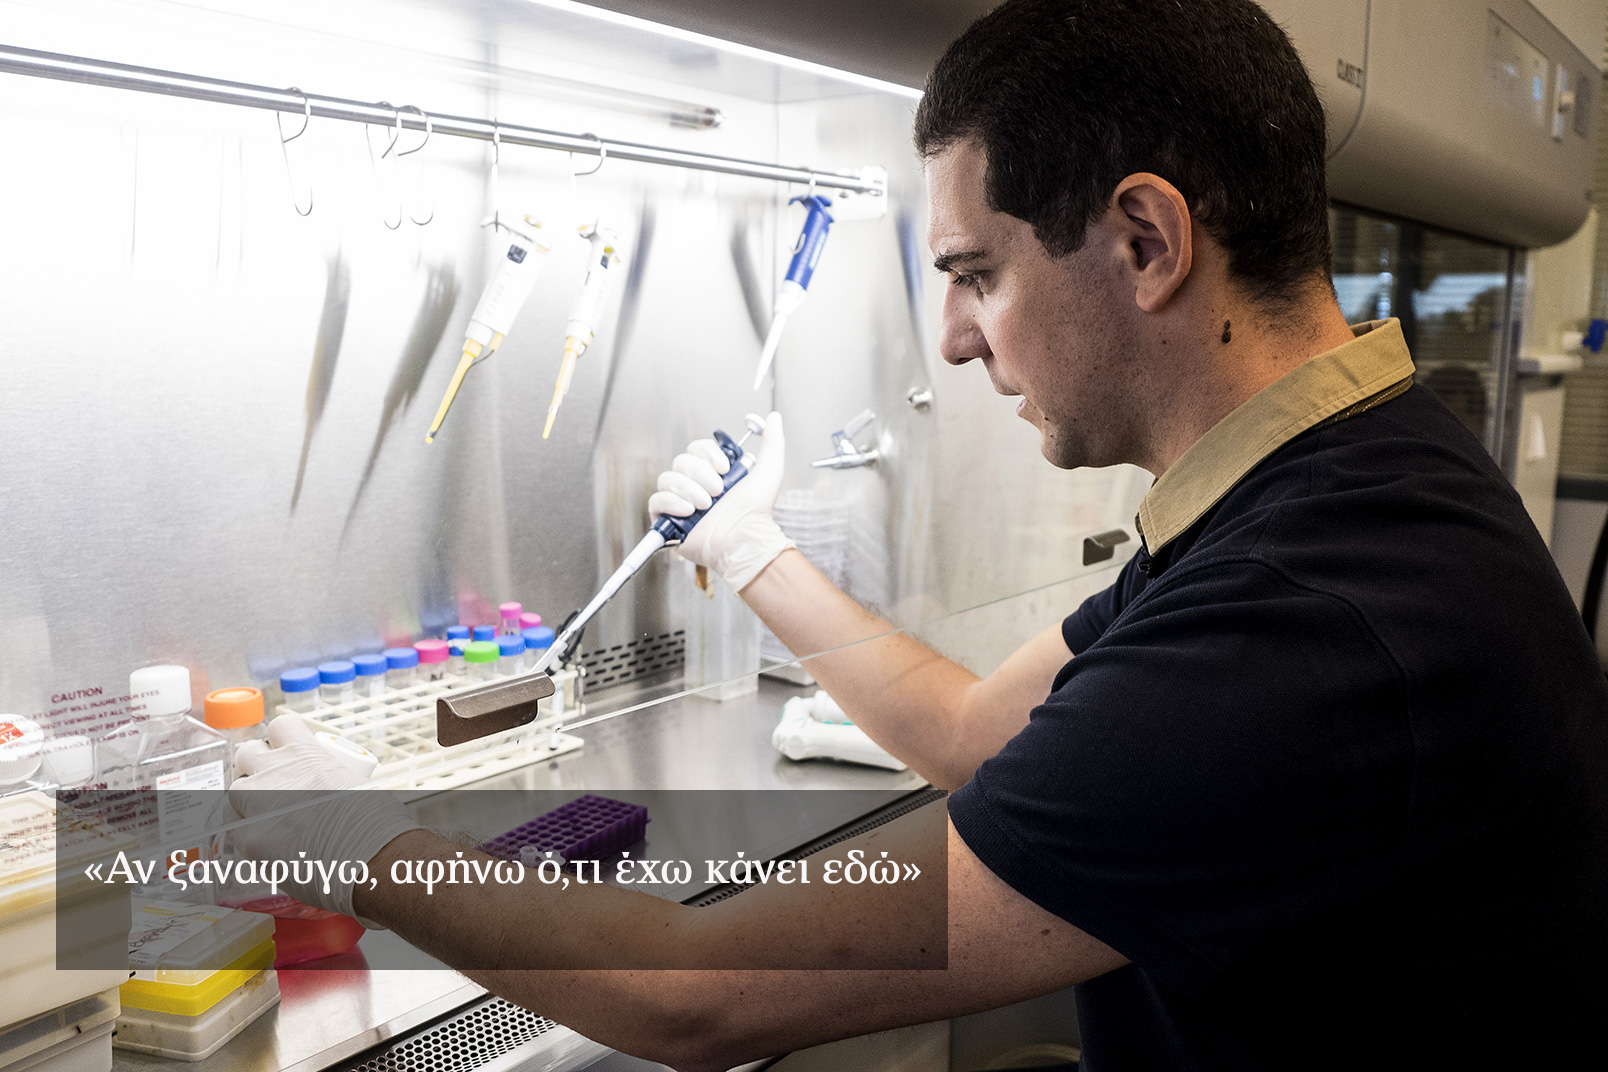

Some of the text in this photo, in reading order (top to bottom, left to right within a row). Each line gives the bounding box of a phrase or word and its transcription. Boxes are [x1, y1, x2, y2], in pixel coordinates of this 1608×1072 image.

[51, 686, 104, 705] CAUTION
[98, 710, 108, 719] AT
[110, 708, 124, 717] ALL
